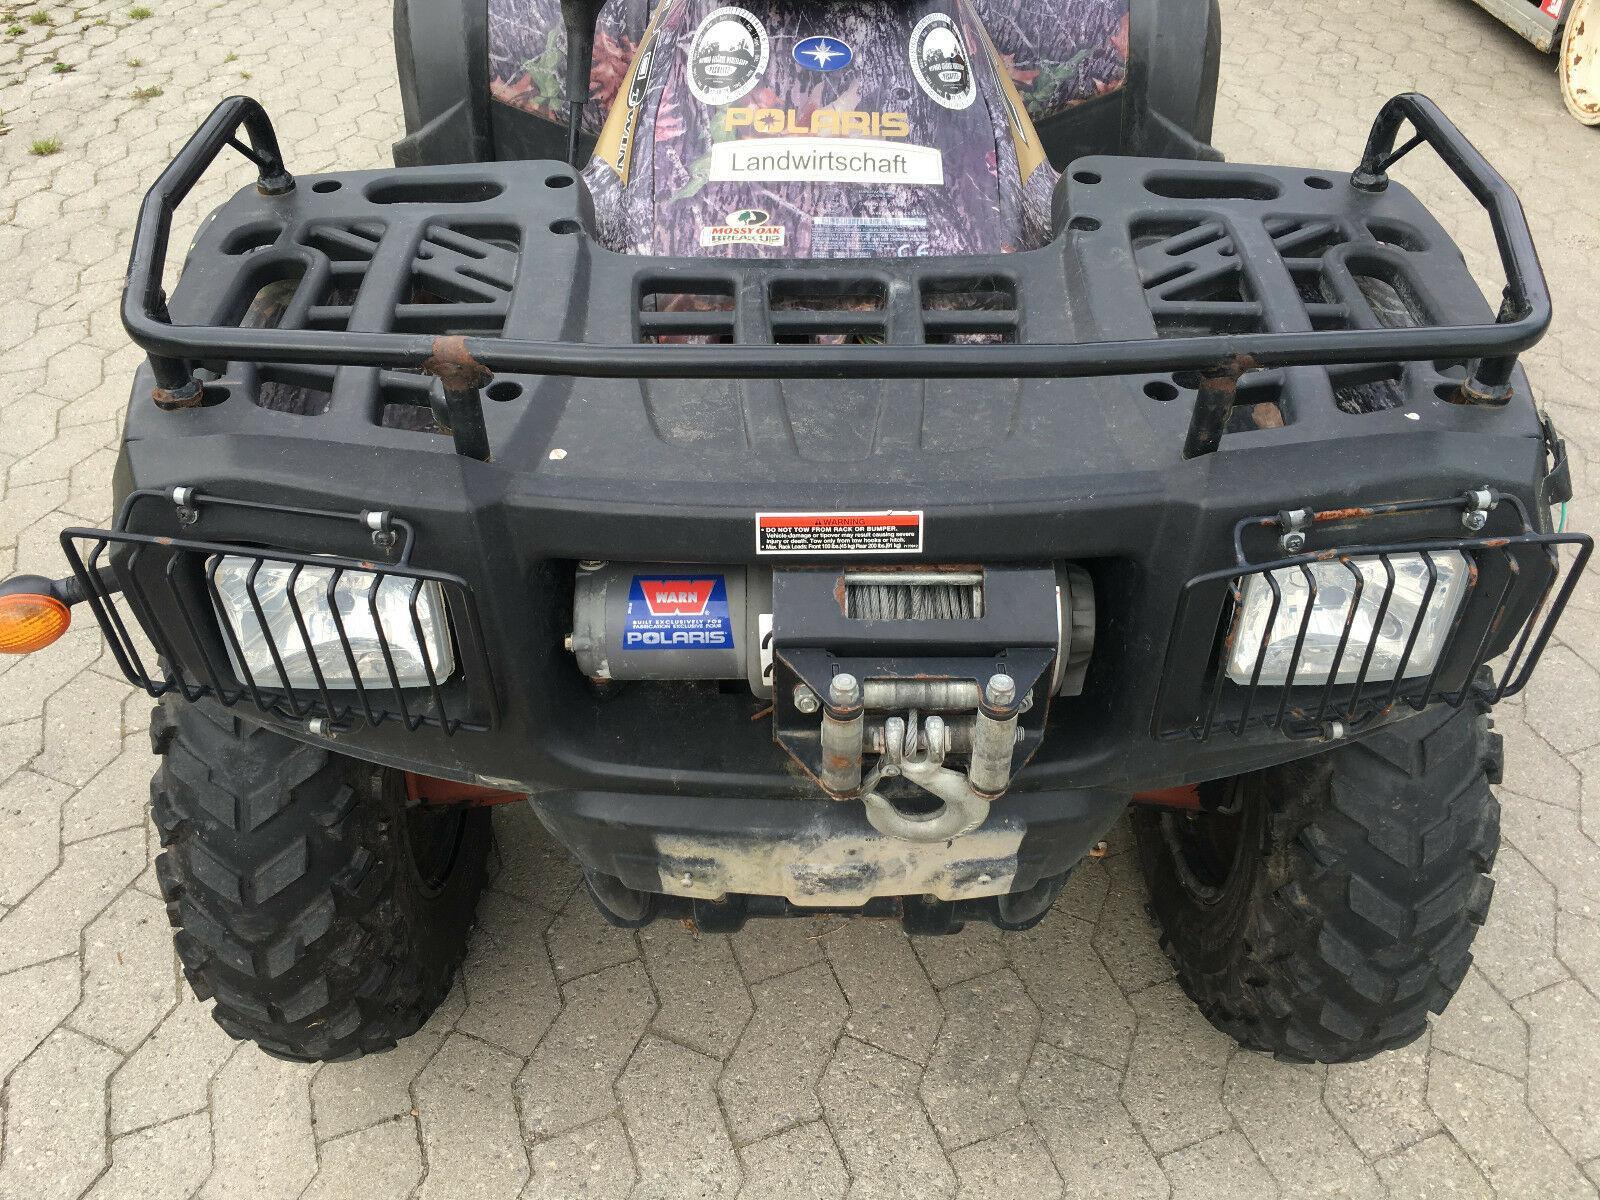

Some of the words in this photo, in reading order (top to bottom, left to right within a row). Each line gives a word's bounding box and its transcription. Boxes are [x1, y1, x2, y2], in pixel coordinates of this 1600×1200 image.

[724, 107, 911, 137] POLARIS
[732, 149, 908, 174] Landwirtschaft
[711, 227, 755, 235] MOSSY
[756, 227, 782, 235] OAK
[655, 591, 698, 604] WARN
[626, 631, 726, 645] POLARIS
